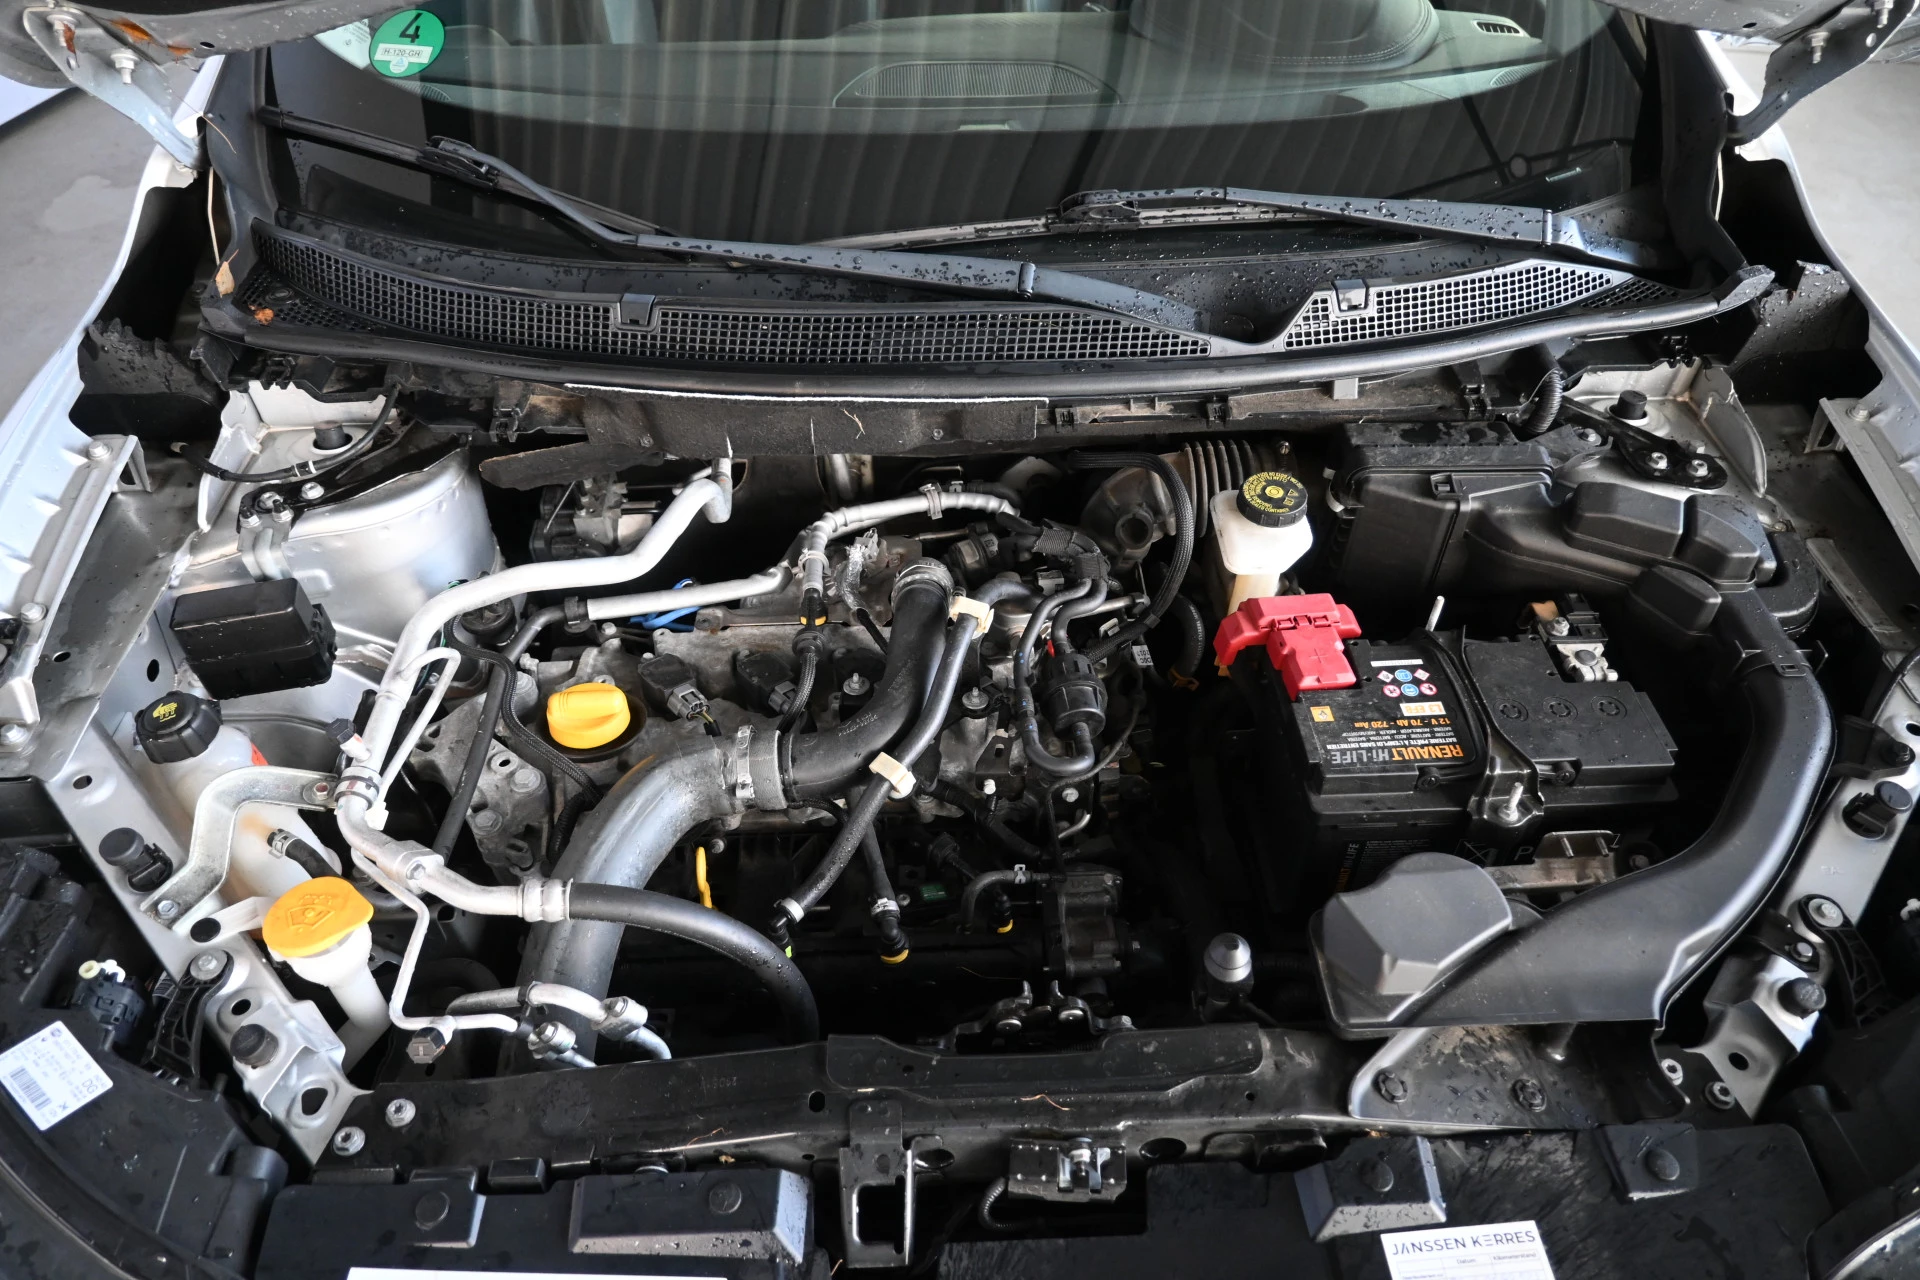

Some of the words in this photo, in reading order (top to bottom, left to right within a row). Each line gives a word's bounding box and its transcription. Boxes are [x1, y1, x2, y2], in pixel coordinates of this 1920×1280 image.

[400, 13, 422, 43] 4
[1404, 705, 1425, 714] EFB
[1428, 703, 1442, 713] L3
[1392, 744, 1463, 761] RENAULT
[1392, 1237, 1466, 1255] JANSSEN
[1471, 1230, 1536, 1246] KERRES
